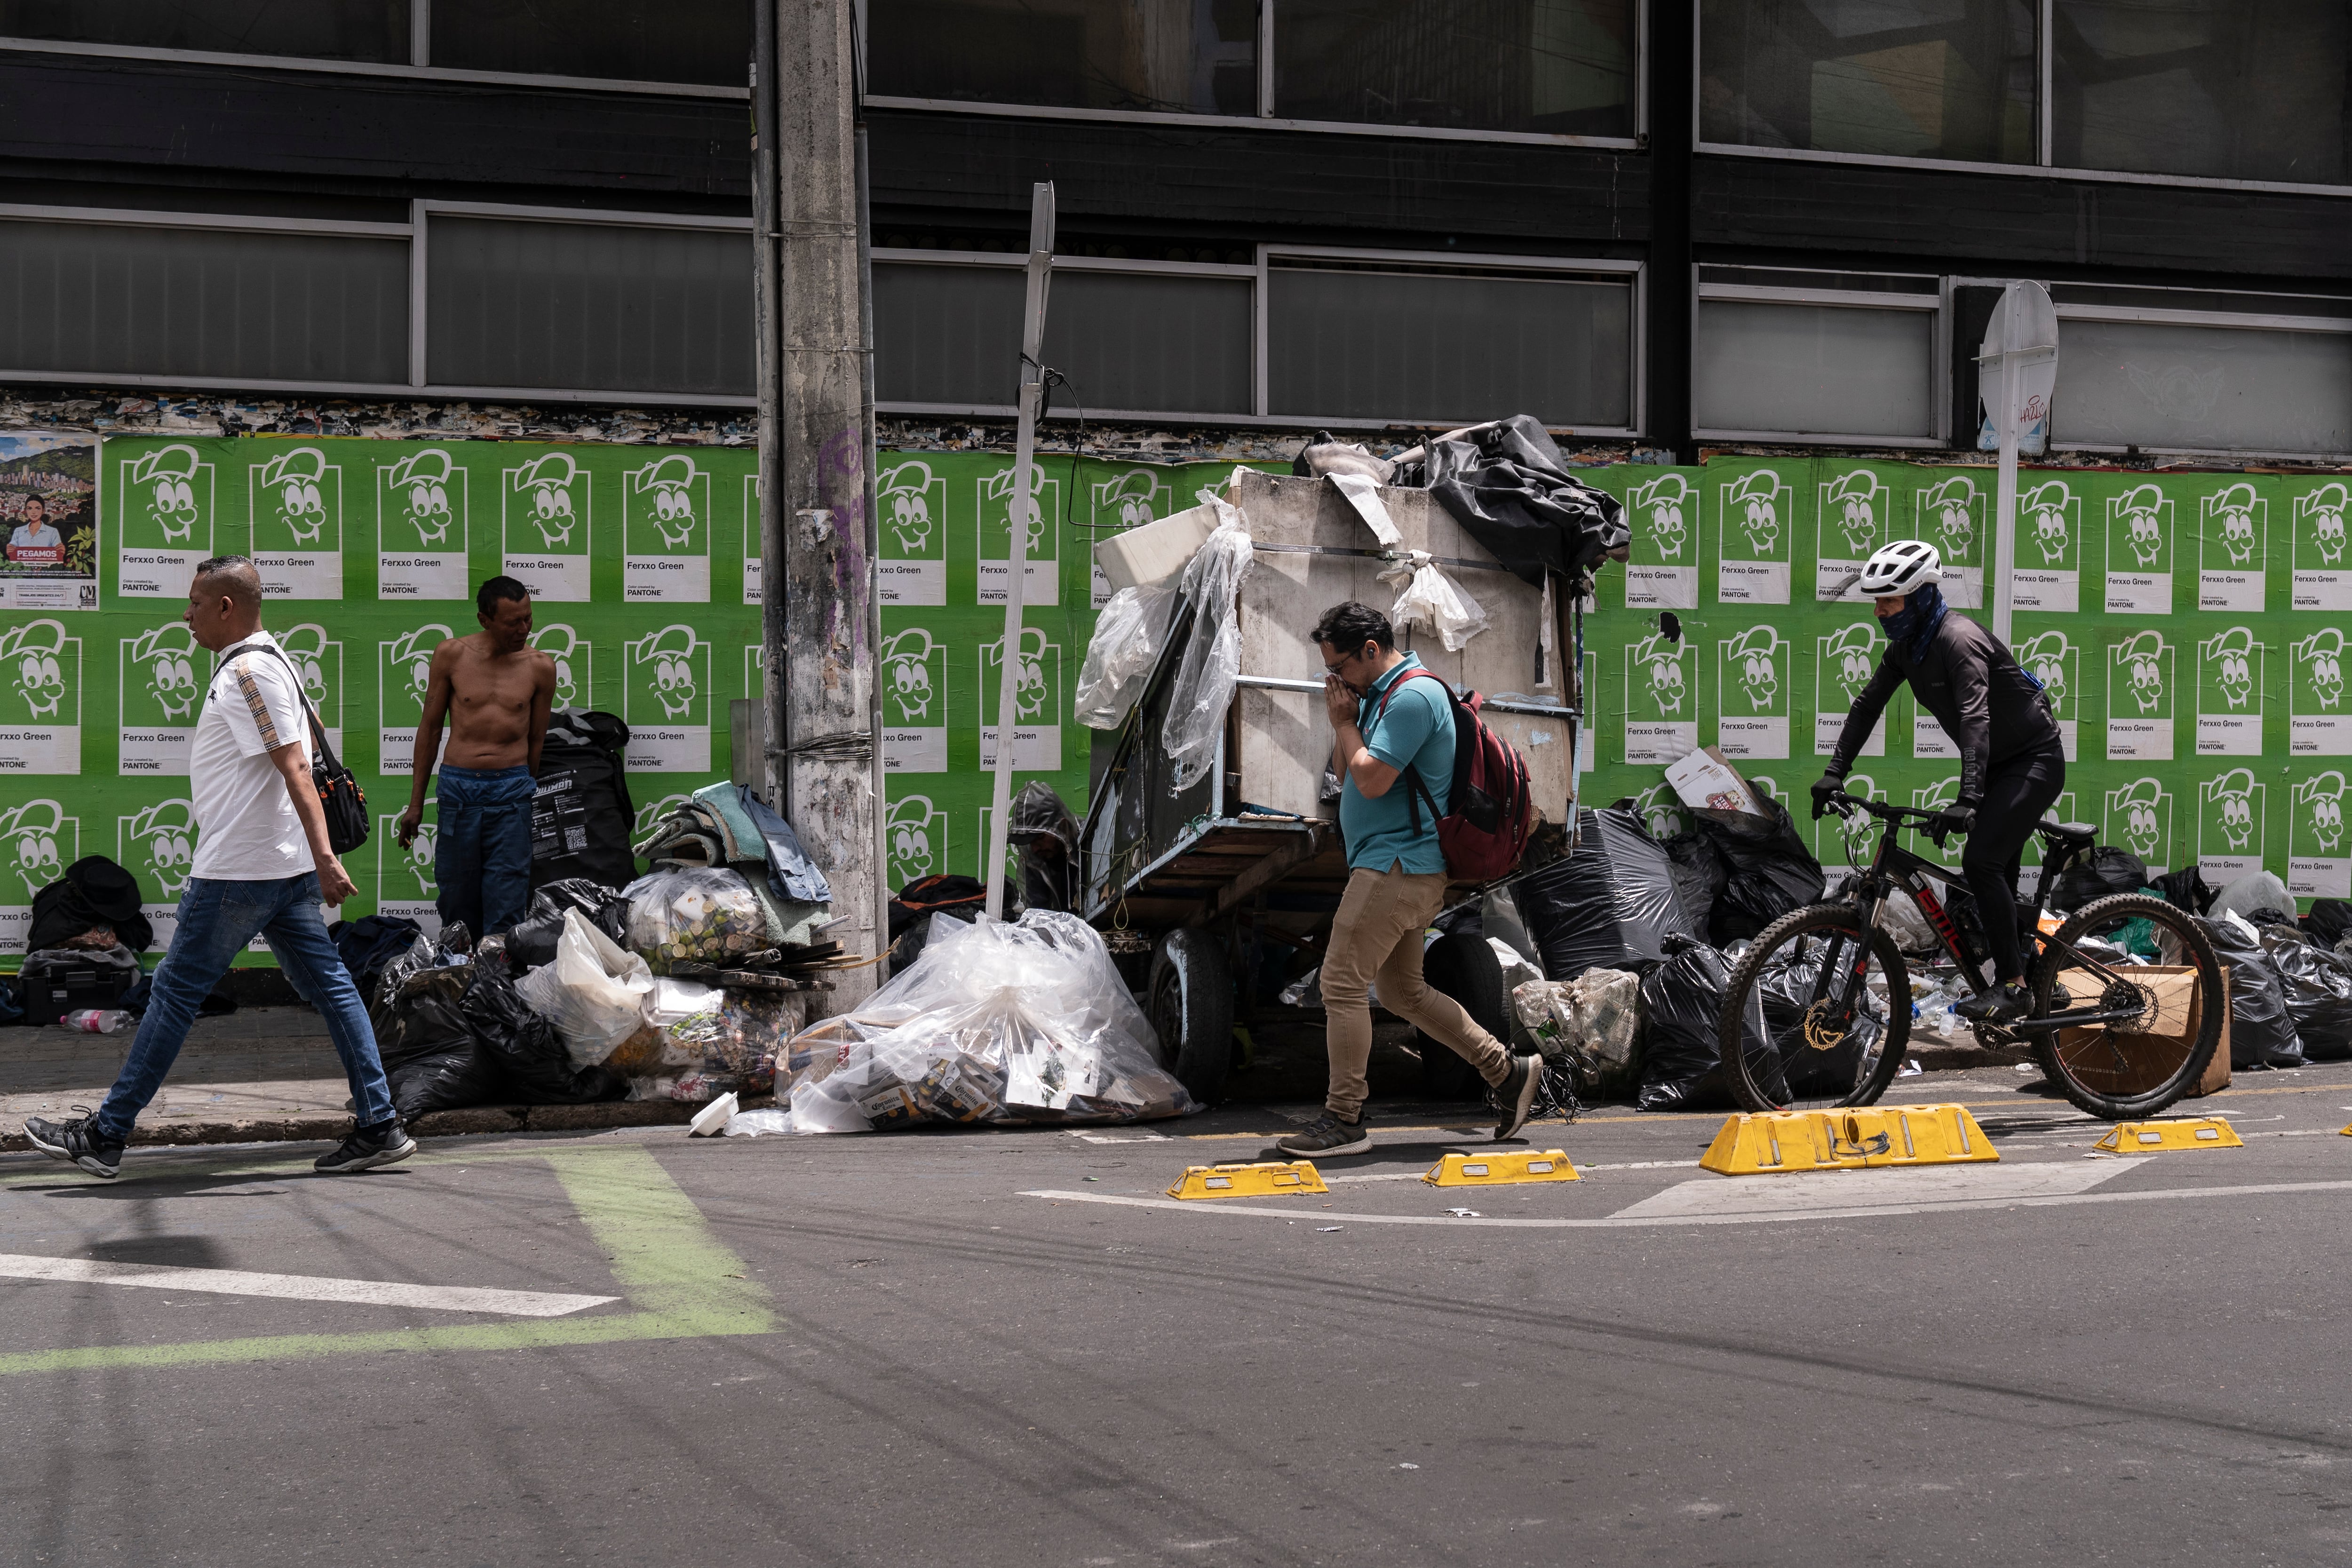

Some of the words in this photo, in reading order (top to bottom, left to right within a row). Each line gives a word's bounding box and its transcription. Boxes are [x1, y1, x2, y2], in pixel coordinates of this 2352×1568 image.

[123, 555, 154, 564] Ferxxo
[157, 556, 184, 565] Green
[1908, 579, 1923, 593] SMITH
[24, 732, 52, 740] Green
[157, 733, 184, 742] Green
[381, 907, 411, 915] Ferxxo
[1917, 888, 1962, 958] BMC
[871, 1096, 900, 1111] Coronita
